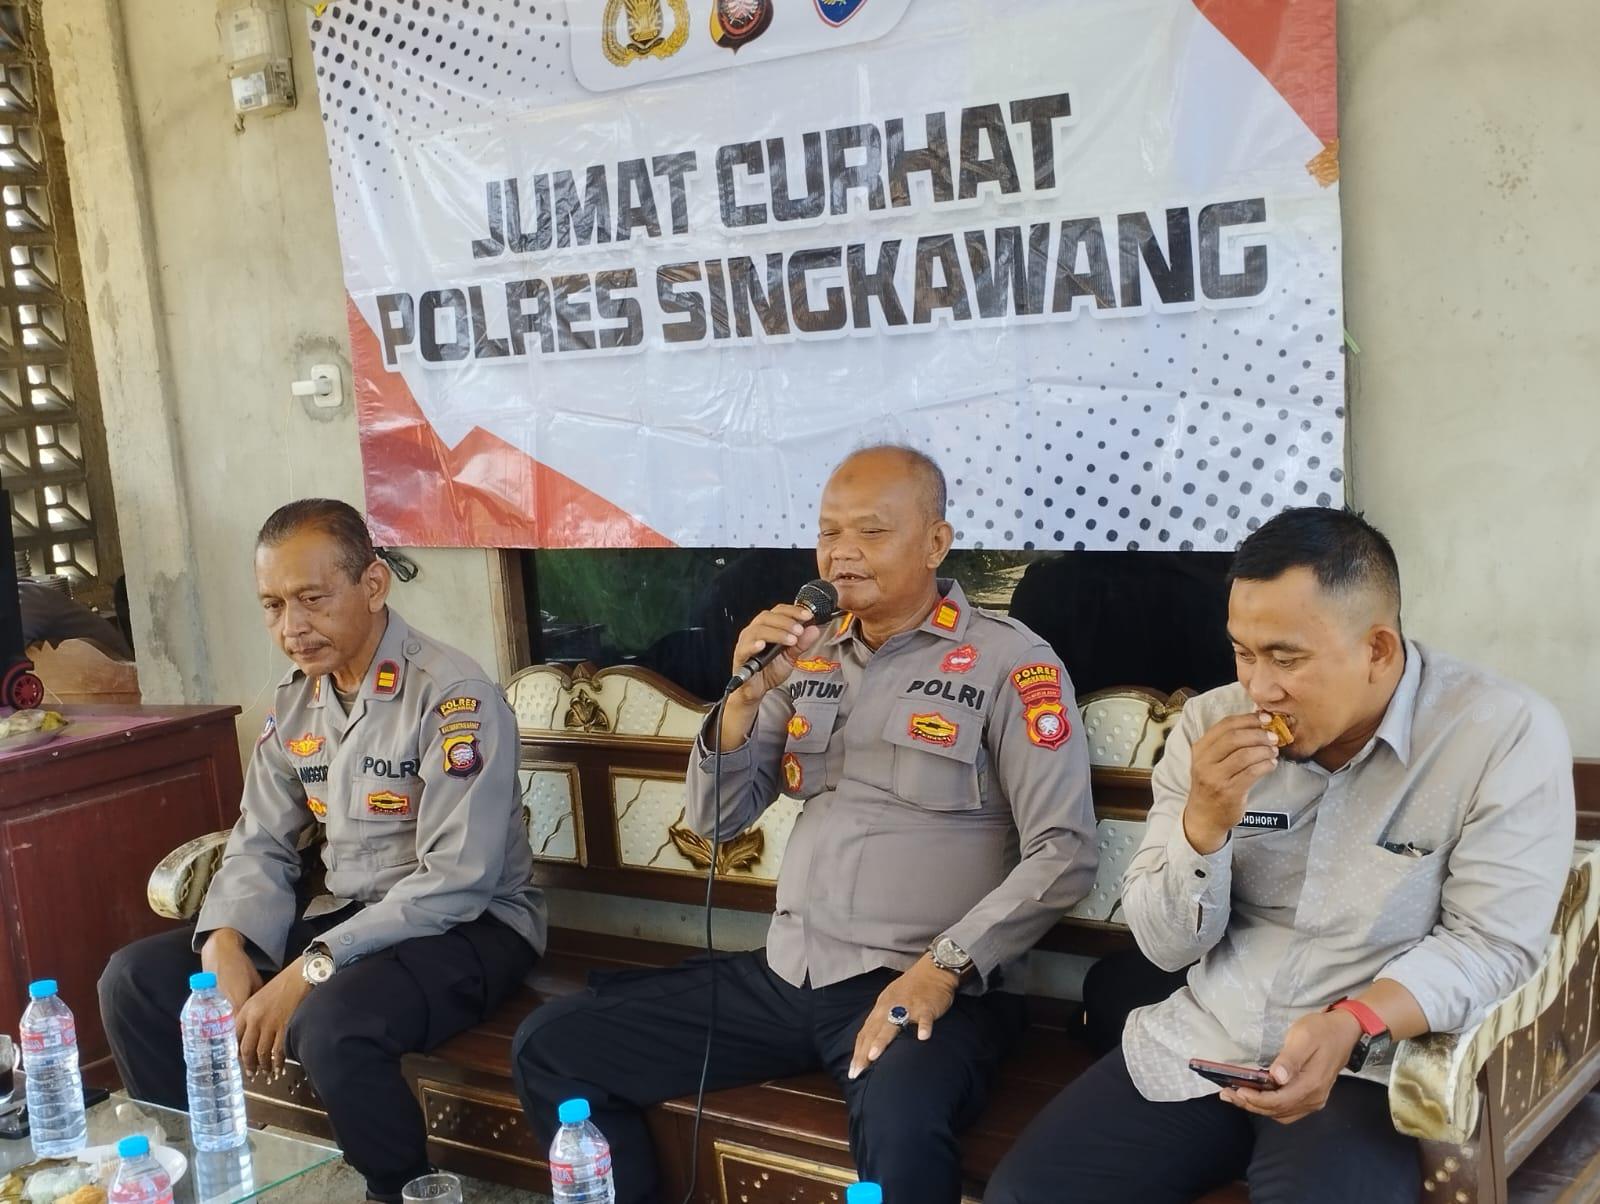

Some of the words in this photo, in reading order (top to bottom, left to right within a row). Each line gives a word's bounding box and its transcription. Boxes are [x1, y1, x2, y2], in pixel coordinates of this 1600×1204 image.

[472, 151, 697, 258] JUMAT
[716, 93, 1071, 227] CURHAT
[376, 268, 644, 365] POLRES
[656, 197, 1268, 343] SINGKAWANG
[1014, 666, 1057, 683] POLRES
[440, 698, 477, 713] POLRES
[906, 680, 985, 710] POLRI
[1241, 815, 1278, 826] HDHORY
